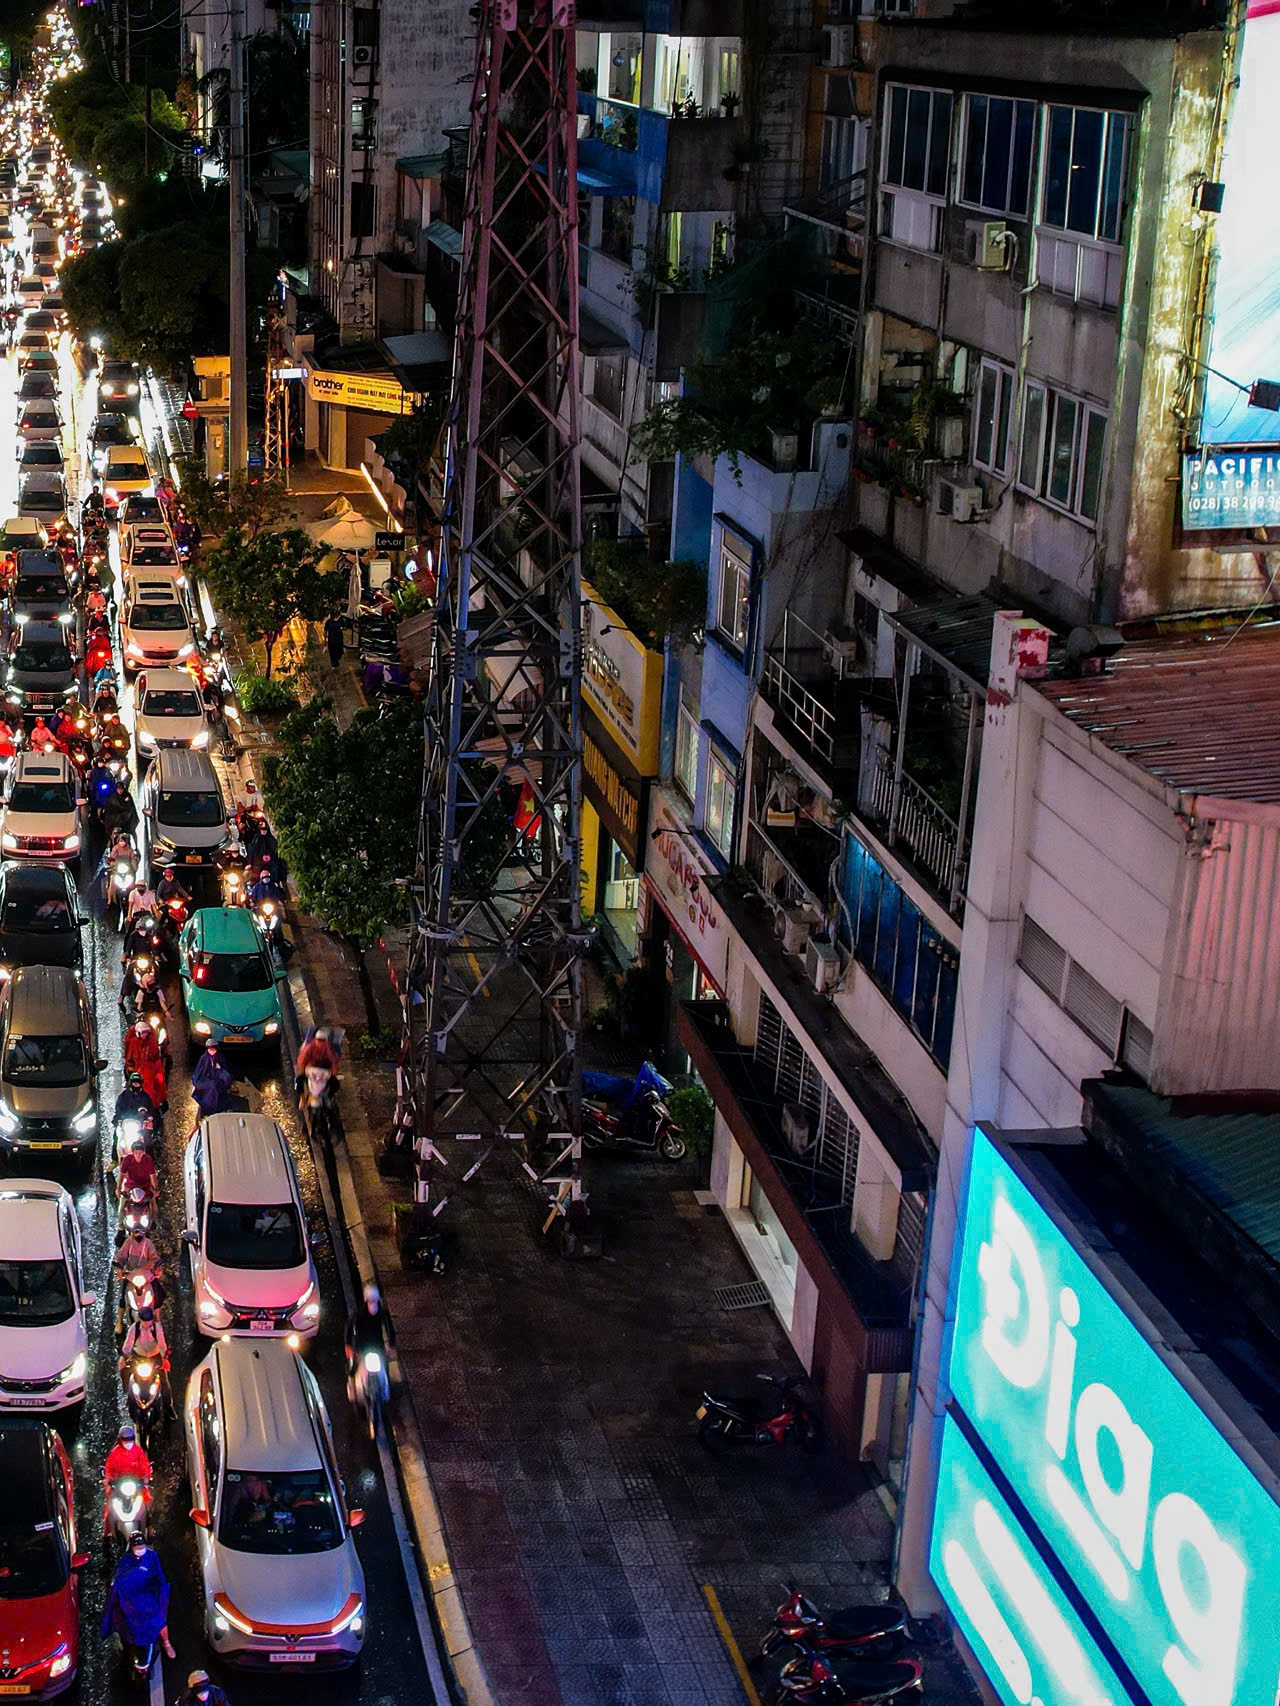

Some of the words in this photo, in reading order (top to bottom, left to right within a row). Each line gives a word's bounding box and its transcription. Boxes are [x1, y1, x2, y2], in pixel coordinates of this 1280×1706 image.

[313, 376, 344, 391] brother
[1190, 457, 1280, 475] PACIFI
[1189, 496, 1220, 512] (028)
[1223, 496, 1238, 510] 38
[376, 537, 403, 546] Lexar
